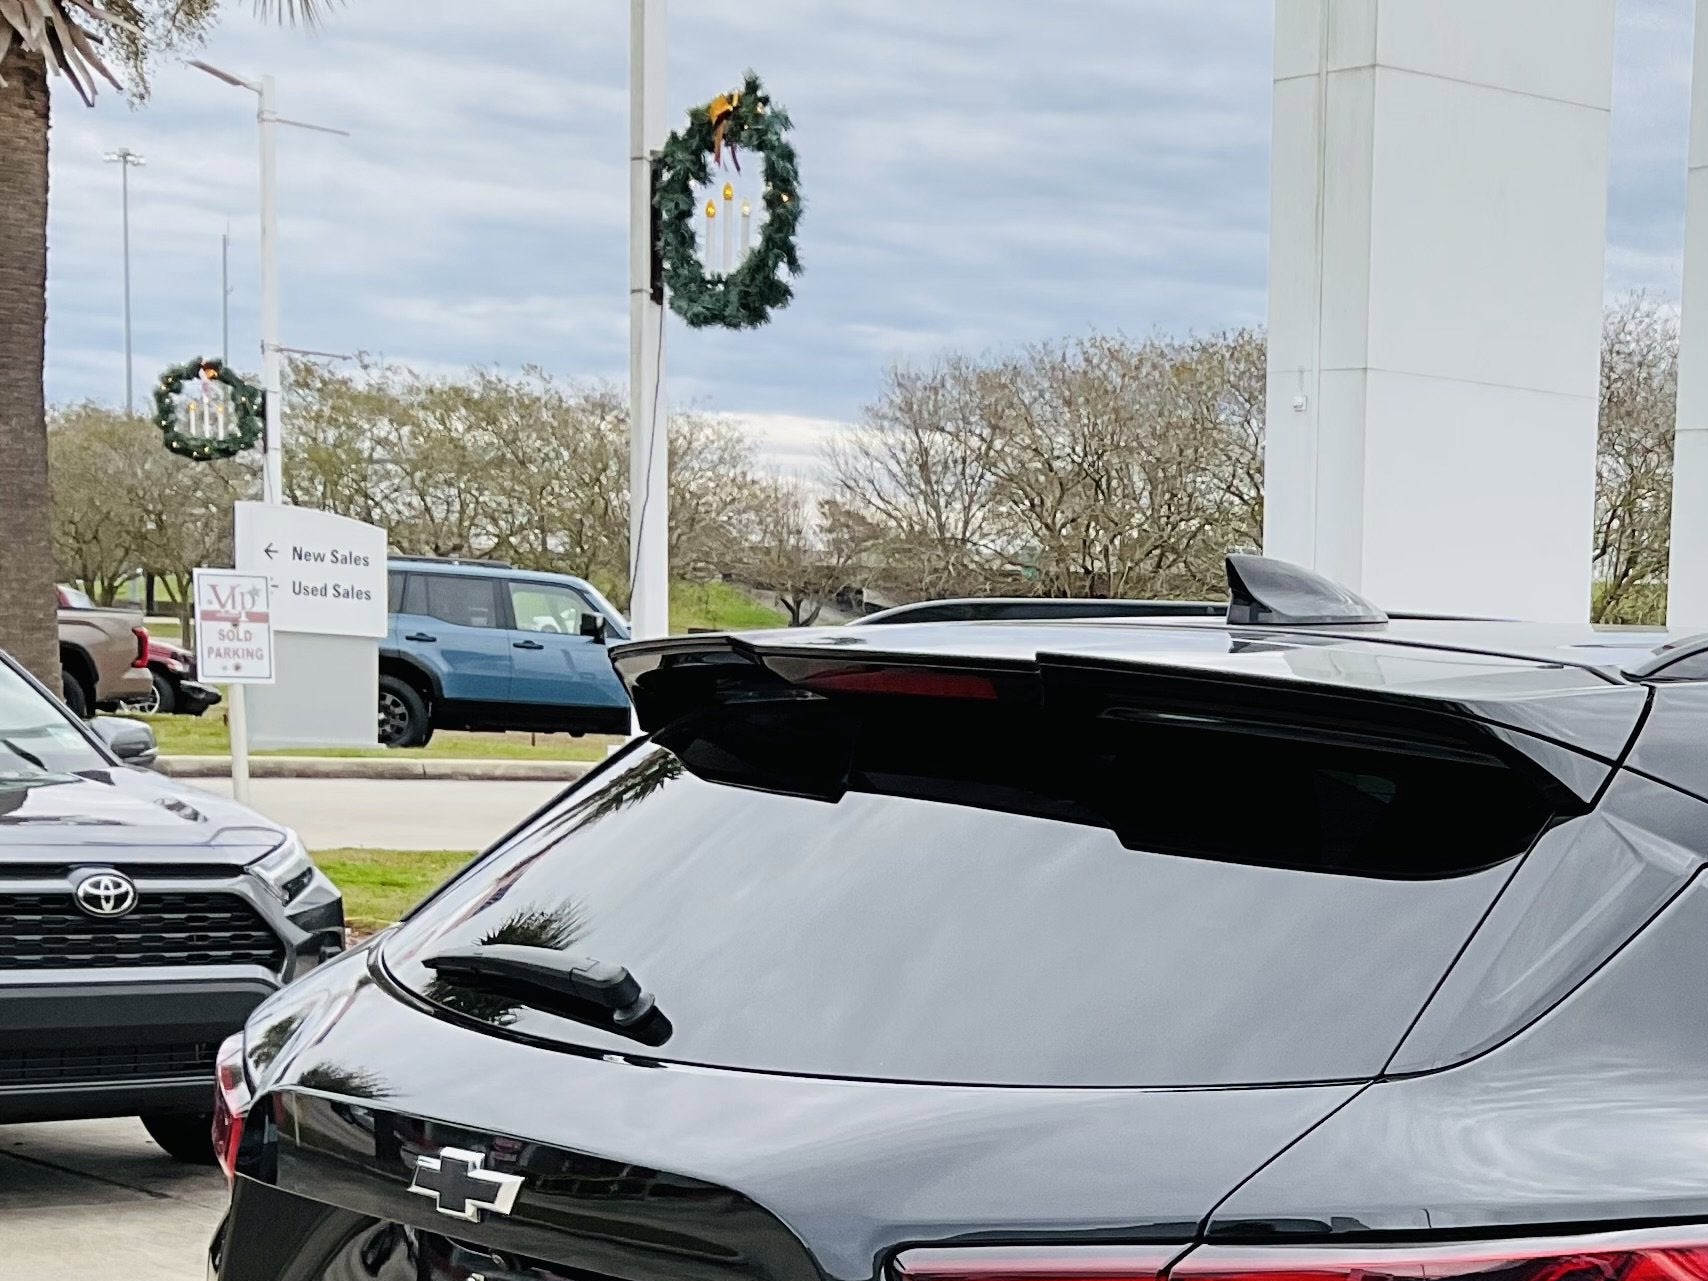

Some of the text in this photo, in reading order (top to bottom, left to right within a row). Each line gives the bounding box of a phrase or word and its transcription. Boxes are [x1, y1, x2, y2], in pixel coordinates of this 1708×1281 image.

[292, 546, 370, 567] New Sales
[292, 580, 372, 601] Used Sales
[217, 629, 253, 642] SOLD
[207, 646, 264, 661] PARKING
